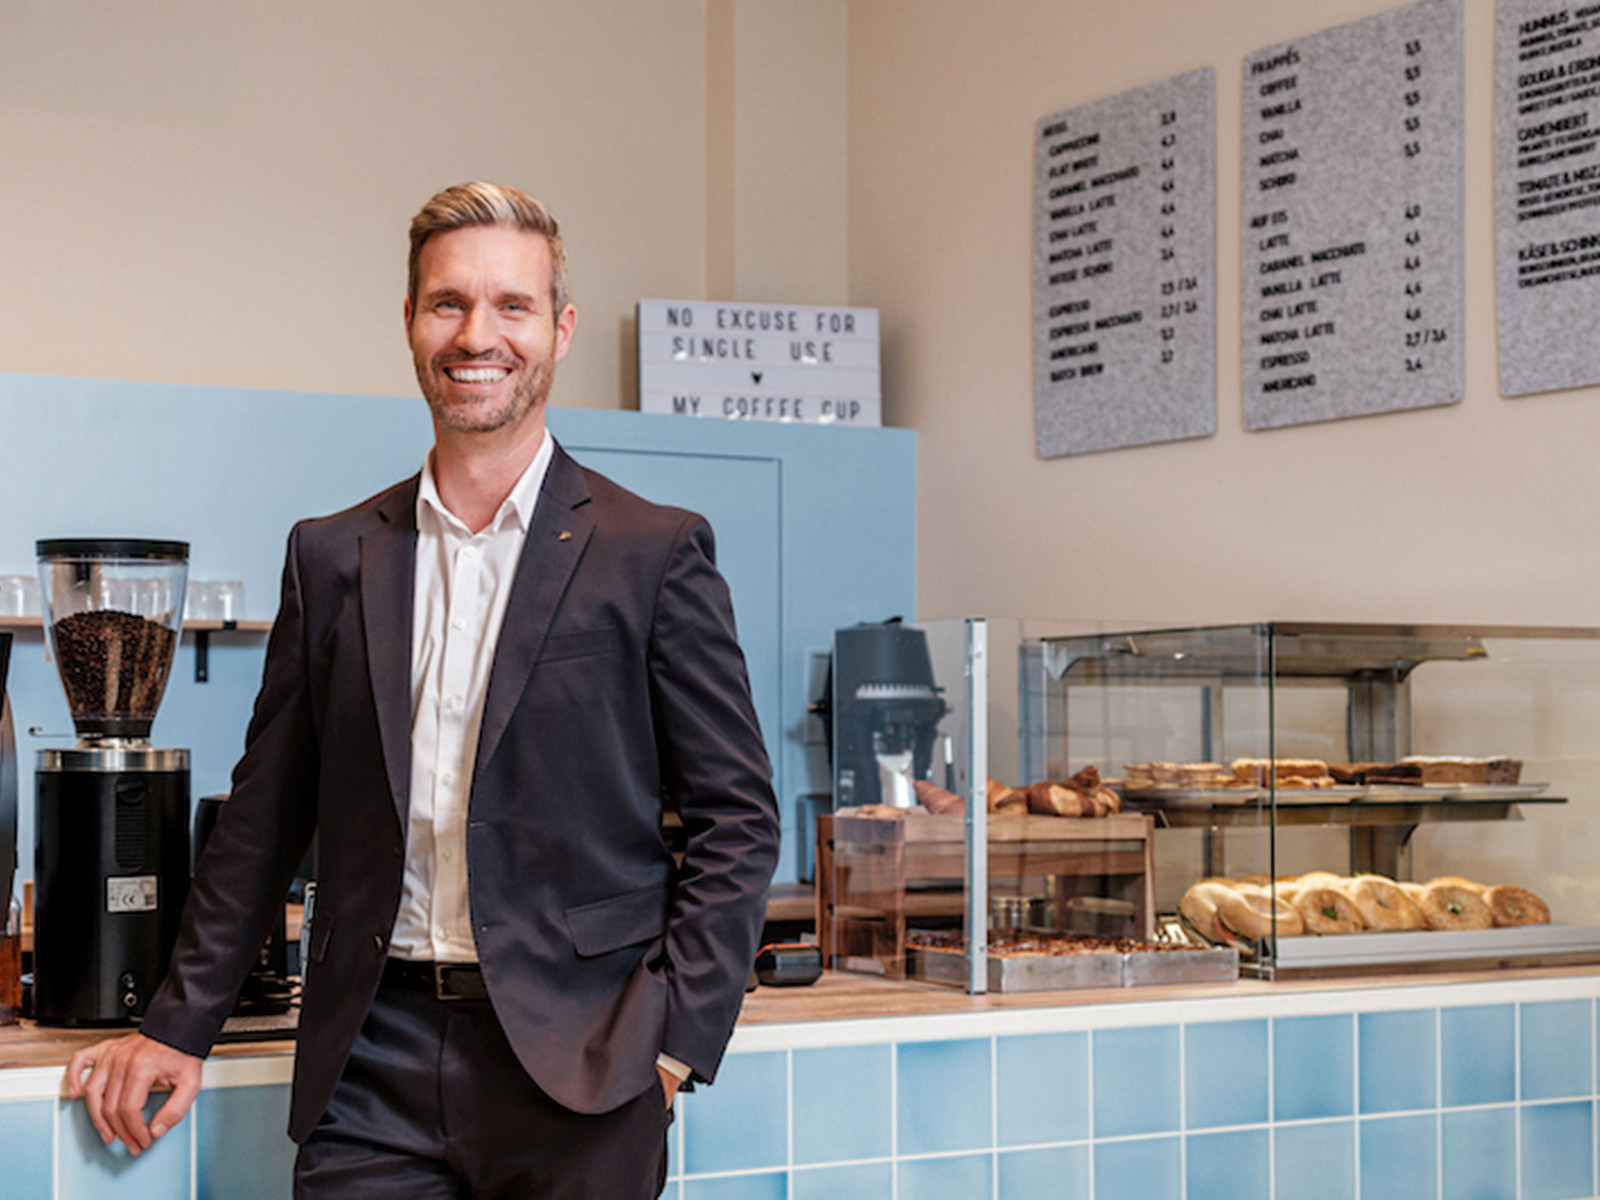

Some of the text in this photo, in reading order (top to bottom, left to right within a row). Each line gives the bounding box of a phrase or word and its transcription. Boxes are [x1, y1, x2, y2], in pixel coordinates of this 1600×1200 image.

[1260, 233, 1290, 252] LATTE
[1311, 270, 1342, 289] LATTE
[1288, 300, 1318, 318] LATTE
[667, 306, 855, 333] NO EXCUSE FOR
[1305, 322, 1336, 339] LATTE
[673, 336, 833, 362] SINGLE USE
[673, 396, 861, 420] MY COFFEE CUP
